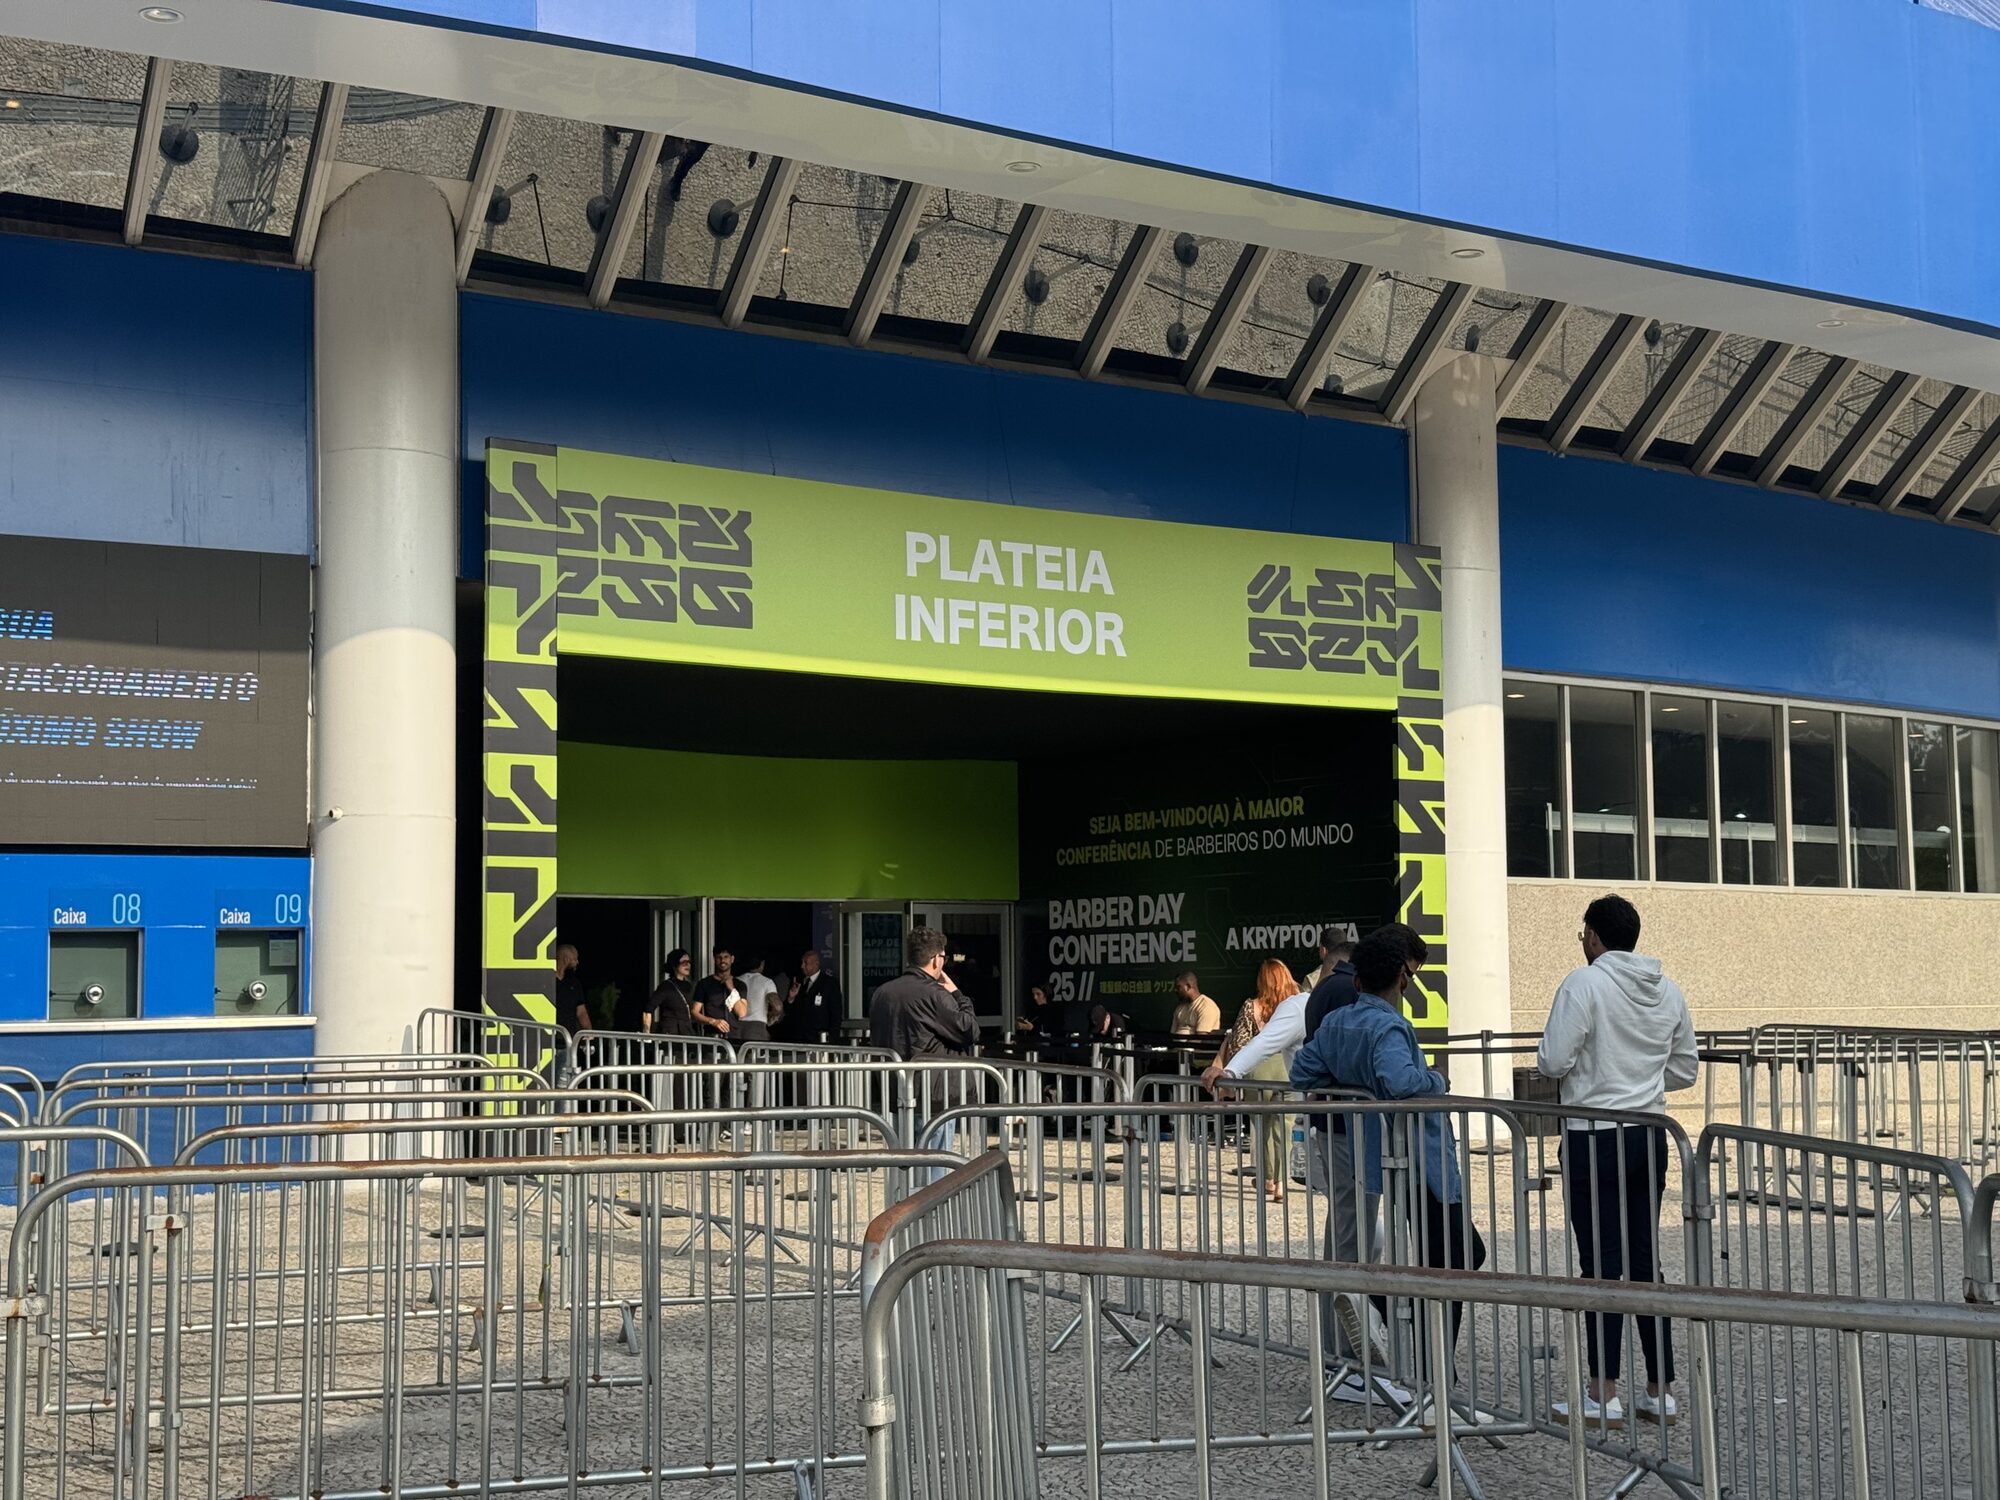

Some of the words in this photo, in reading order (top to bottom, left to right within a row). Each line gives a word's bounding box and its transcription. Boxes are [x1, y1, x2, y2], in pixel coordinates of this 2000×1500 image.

[905, 530, 1115, 595] PLATEIA
[895, 593, 1127, 657] INFERIOR
[0, 662, 259, 701] TACIONAMENTO
[103, 716, 204, 750] SHOW
[1089, 813, 1122, 835] SEJA
[1124, 802, 1229, 832] BEM-VINDO(A)
[1233, 796, 1245, 821] À
[1249, 796, 1304, 820] MAIOR
[1056, 839, 1151, 866] CONFERÊNCIA
[1155, 838, 1174, 858] DE
[1176, 831, 1258, 857] BARBEIROS
[1263, 828, 1287, 849] DO
[1290, 823, 1353, 847] MUNDO
[53, 908, 87, 925] Caixa
[112, 893, 141, 925] 08
[219, 908, 251, 925] Caixa
[275, 893, 302, 924] 09
[1049, 896, 1134, 930] BARBER
[1139, 893, 1185, 925] DAY
[1049, 930, 1197, 966] CONFERENCE
[1225, 928, 1240, 950] A
[1049, 971, 1075, 1001] 25
